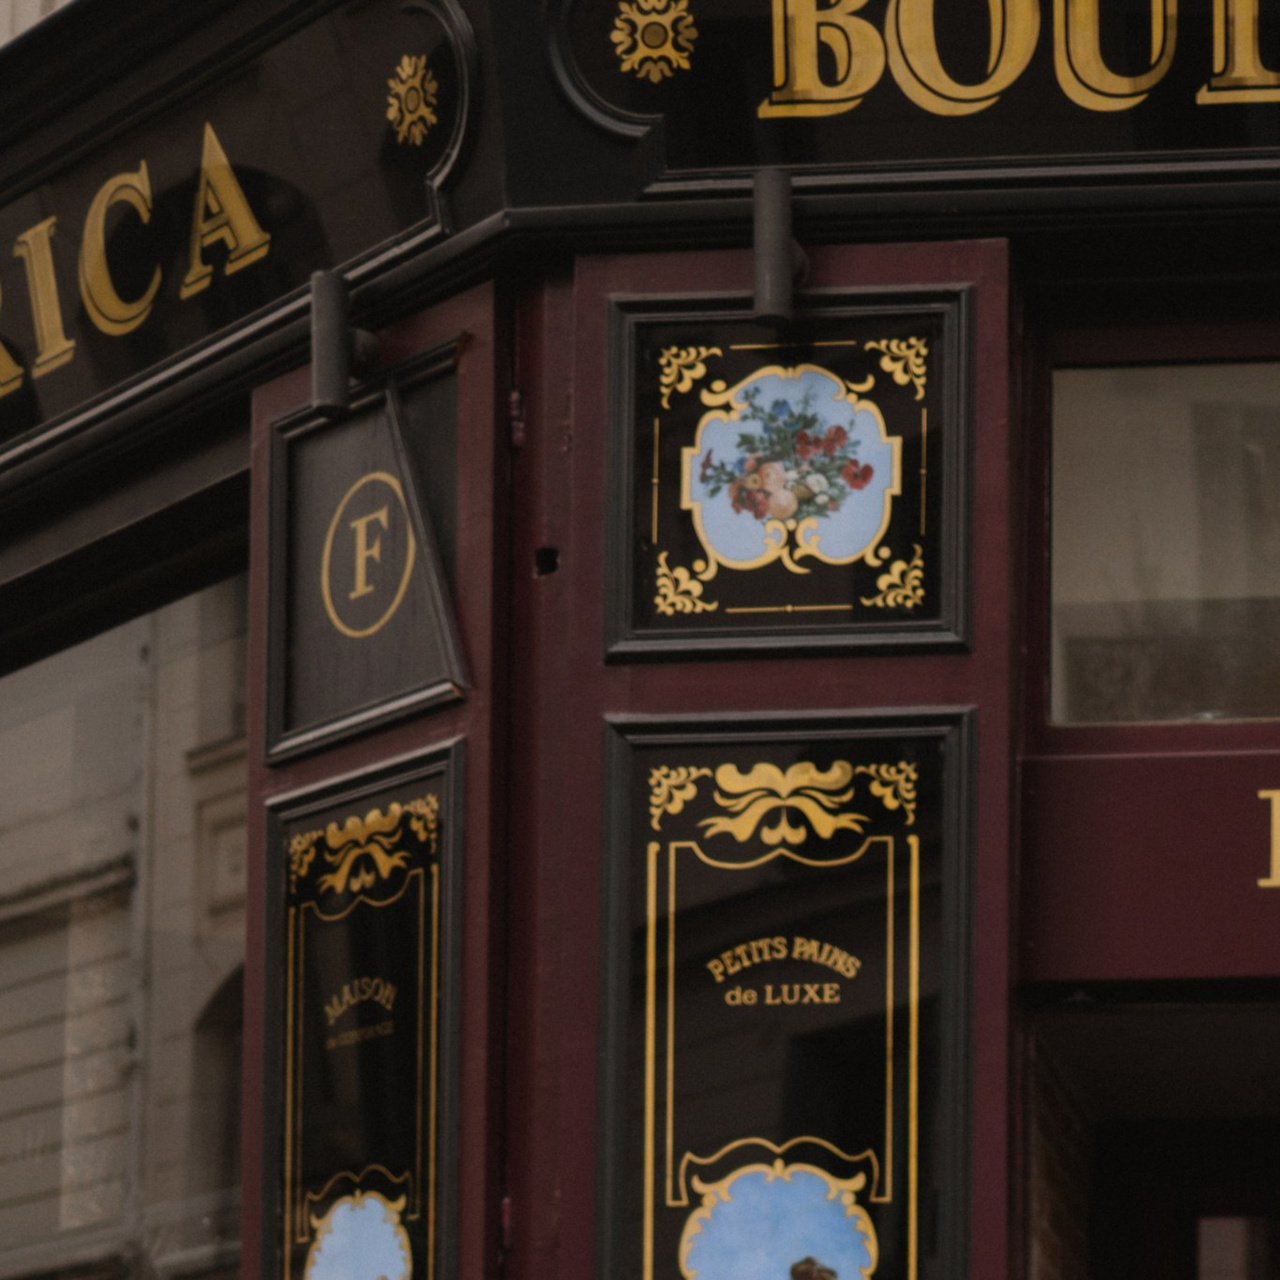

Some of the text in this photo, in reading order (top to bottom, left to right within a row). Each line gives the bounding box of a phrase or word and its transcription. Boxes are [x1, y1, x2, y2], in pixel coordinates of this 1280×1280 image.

[0, 121, 271, 397] ICA
[349, 506, 388, 600] F
[706, 936, 862, 983] PETITS PAINS
[323, 976, 397, 1027] MAISON
[724, 983, 841, 1006] de LUXE
